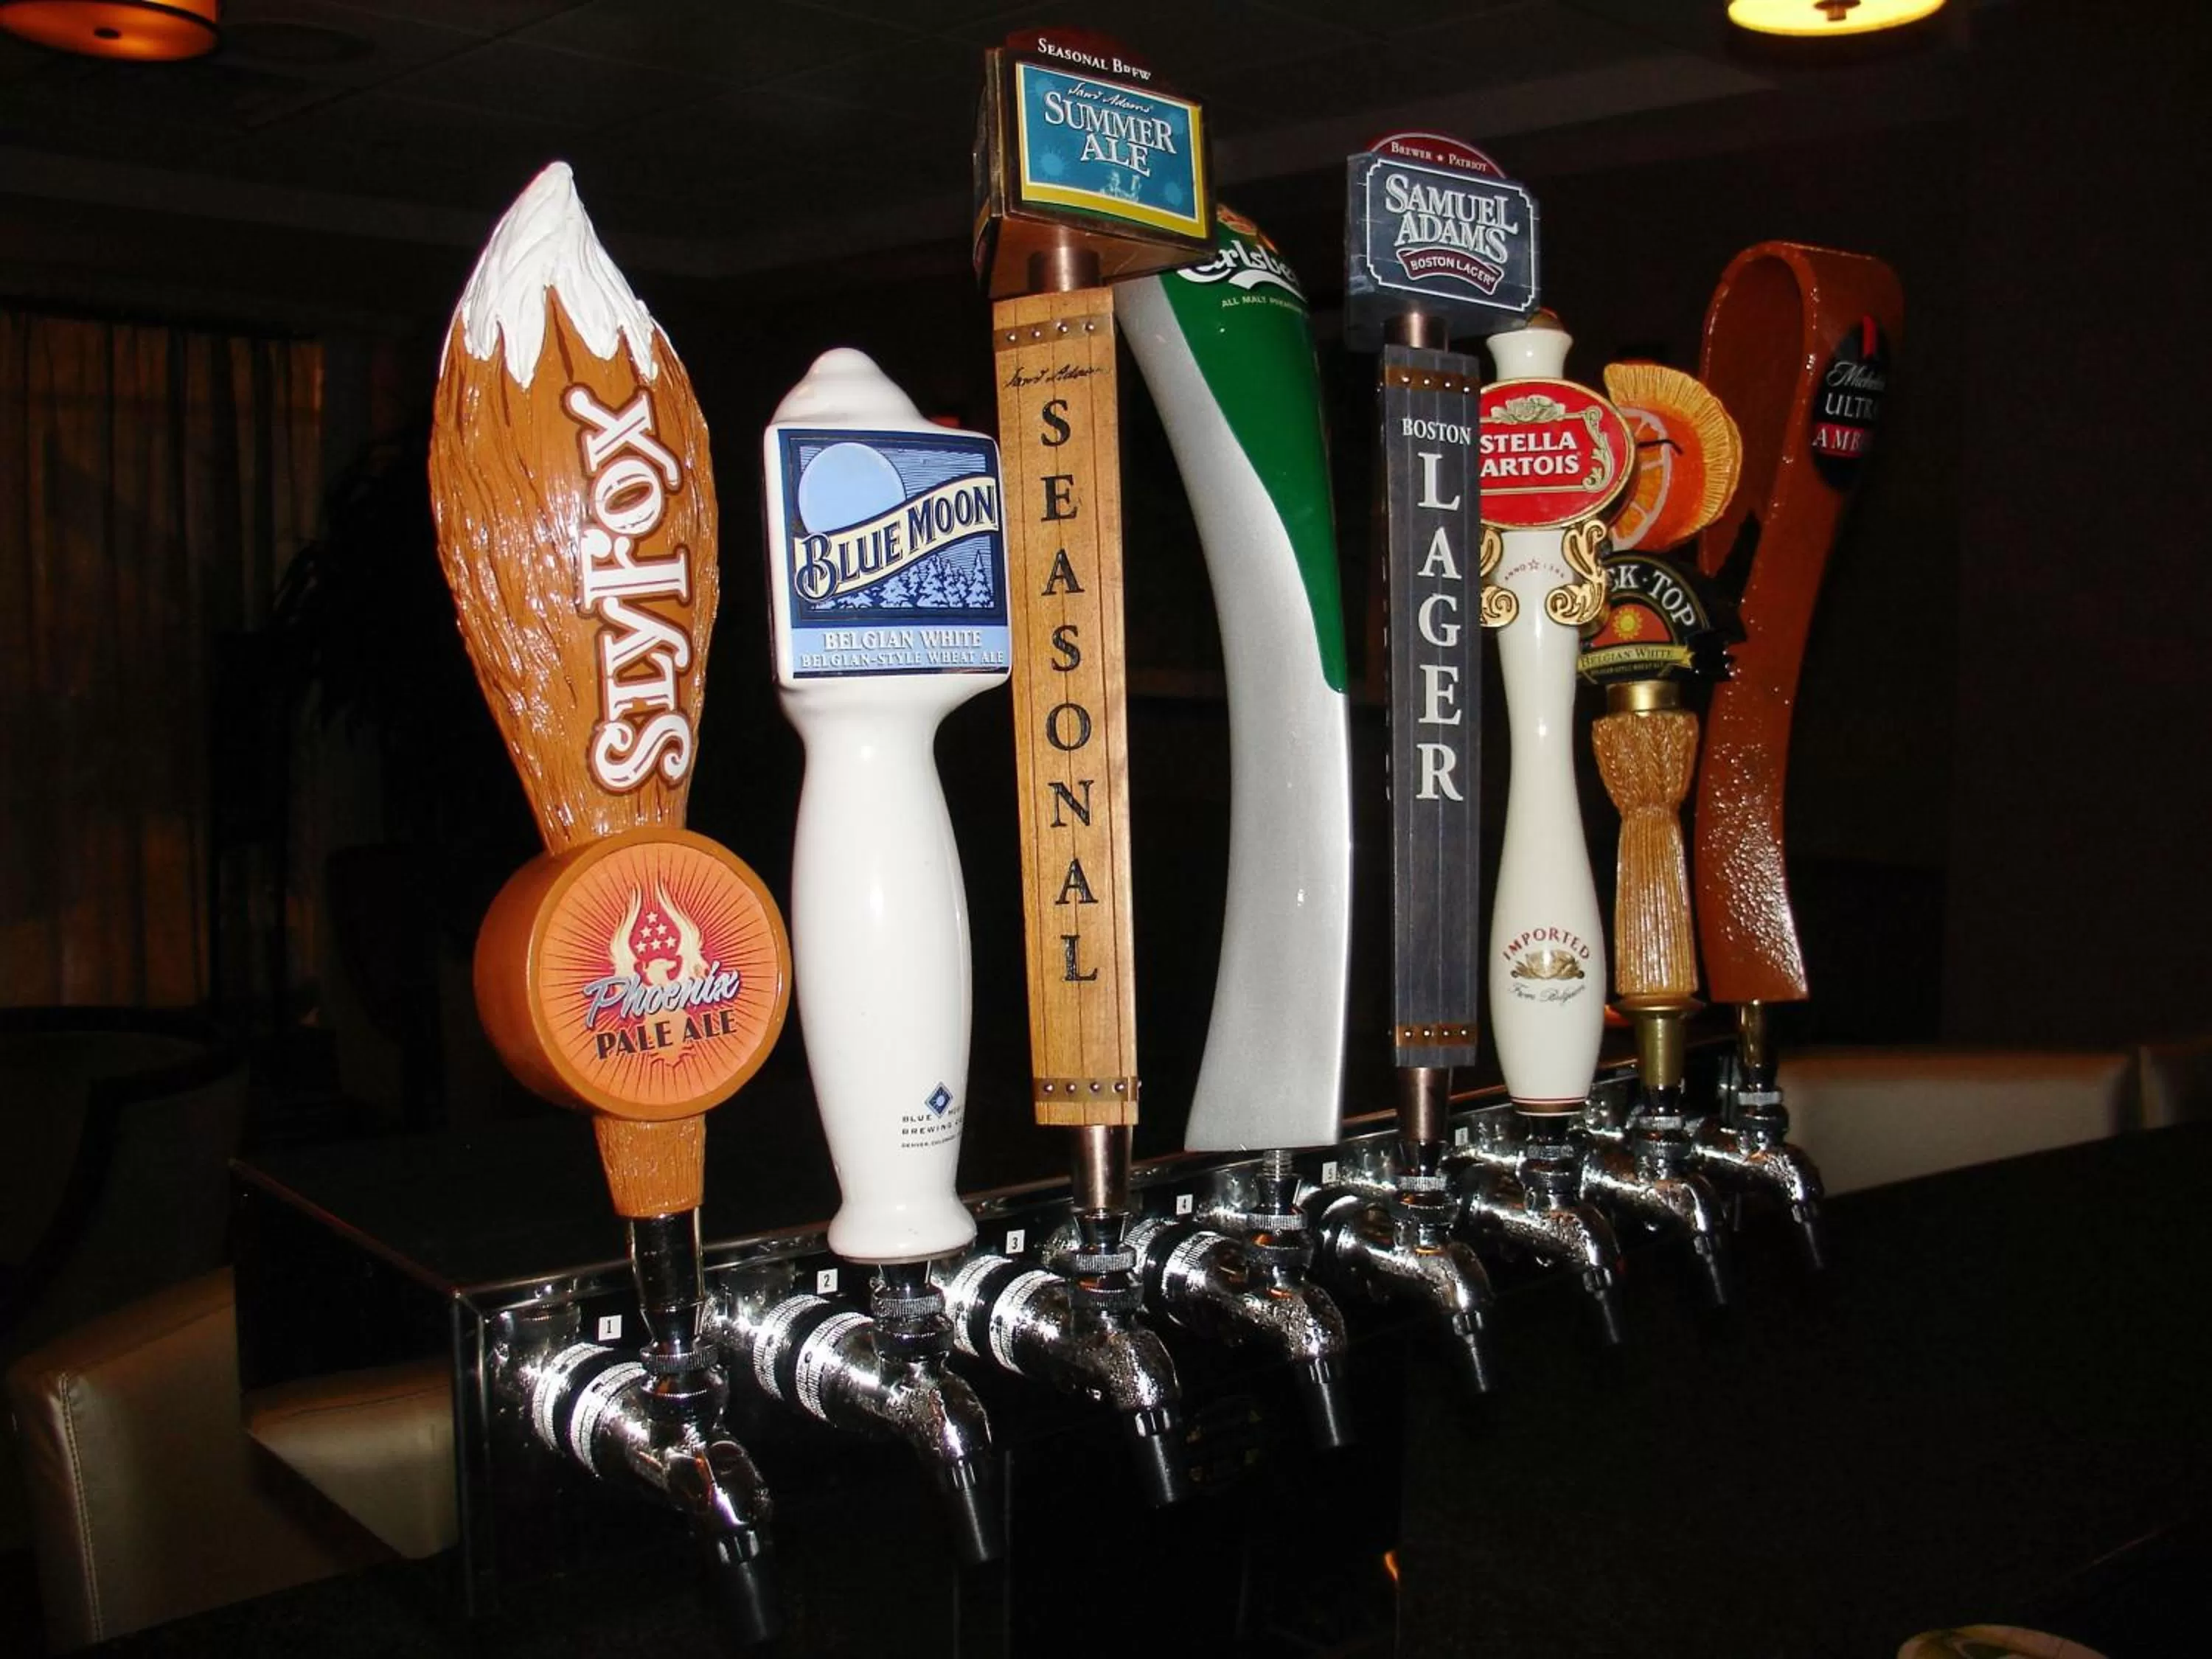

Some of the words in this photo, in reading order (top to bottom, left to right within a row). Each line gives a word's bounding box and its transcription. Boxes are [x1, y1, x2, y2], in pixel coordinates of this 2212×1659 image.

[1037, 38, 1107, 70] SEASONAL
[1045, 91, 1177, 153] SUMMER
[1080, 133, 1150, 177] ALE
[1391, 142, 1432, 160] BREWER
[1449, 153, 1486, 172] PATRIOT
[1385, 174, 1518, 234] SAMUEL
[1394, 212, 1508, 264] ADAMS
[1411, 257, 1455, 271] BOSTON
[1221, 296, 1239, 308] ALL
[1242, 295, 1267, 305] MALT
[1402, 418, 1472, 445] BOSTON
[1479, 432, 1577, 453] STELLA
[1480, 455, 1580, 478] ARTOIS
[796, 521, 902, 602] BLUE
[908, 484, 996, 552] MOON
[824, 630, 914, 651] BELGIAN
[920, 630, 982, 649] WHITE
[1416, 452, 1464, 801] LAGER
[801, 652, 922, 667] BELGIAN-STYLE
[927, 651, 975, 664] WHEAT
[981, 650, 1004, 664] ALE
[1635, 647, 1673, 658] WHITE
[1039, 398, 1099, 982] SEASONAL
[1503, 927, 1590, 961] IMPORTED
[584, 961, 741, 1028] Phoenix
[597, 1020, 674, 1060] PALE
[682, 1009, 738, 1042] ALE
[1012, 1237, 1018, 1250] 3
[824, 1273, 831, 1288] 2
